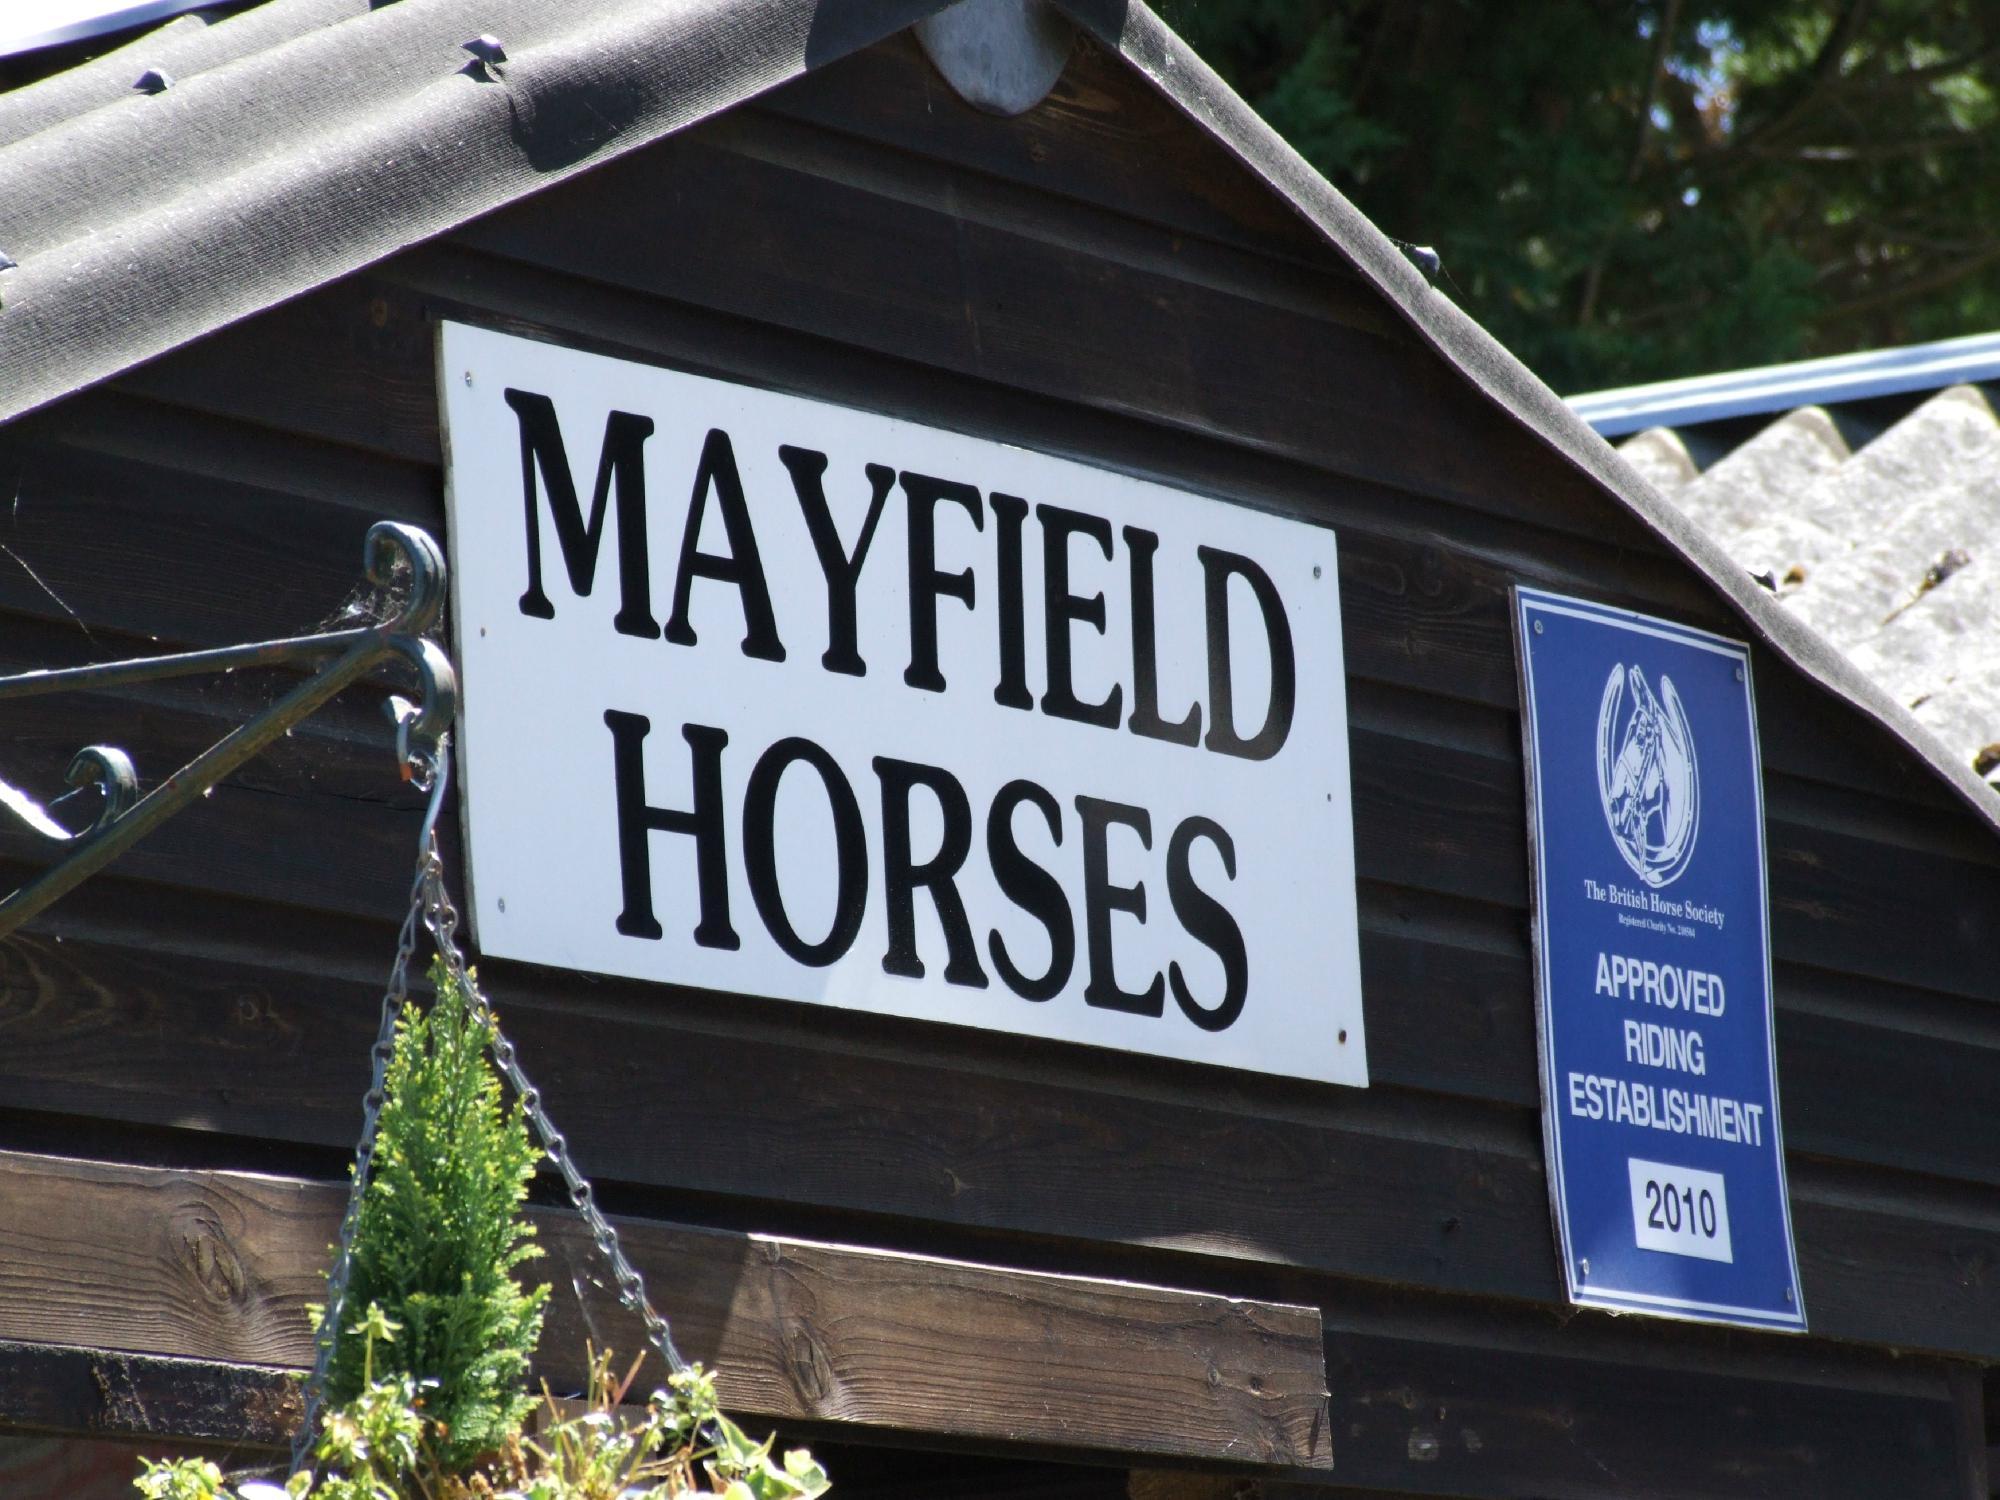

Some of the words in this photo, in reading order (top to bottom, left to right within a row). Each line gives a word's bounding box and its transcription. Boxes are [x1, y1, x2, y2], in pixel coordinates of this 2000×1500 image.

[504, 387, 1296, 762] MAYFIELD
[603, 709, 1249, 1032] HORSES
[1584, 879, 1606, 902] The
[1609, 884, 1648, 910] British
[1650, 893, 1683, 917] Horse
[1685, 900, 1725, 930] Society
[1618, 913, 1646, 928] Registered
[1647, 918, 1666, 935] Charity
[1595, 952, 1726, 1017] APPROVED
[1624, 1020, 1706, 1076] RIDING
[1568, 1072, 1764, 1147] ESTABLISHMENT
[1645, 1180, 1717, 1240] 2010
